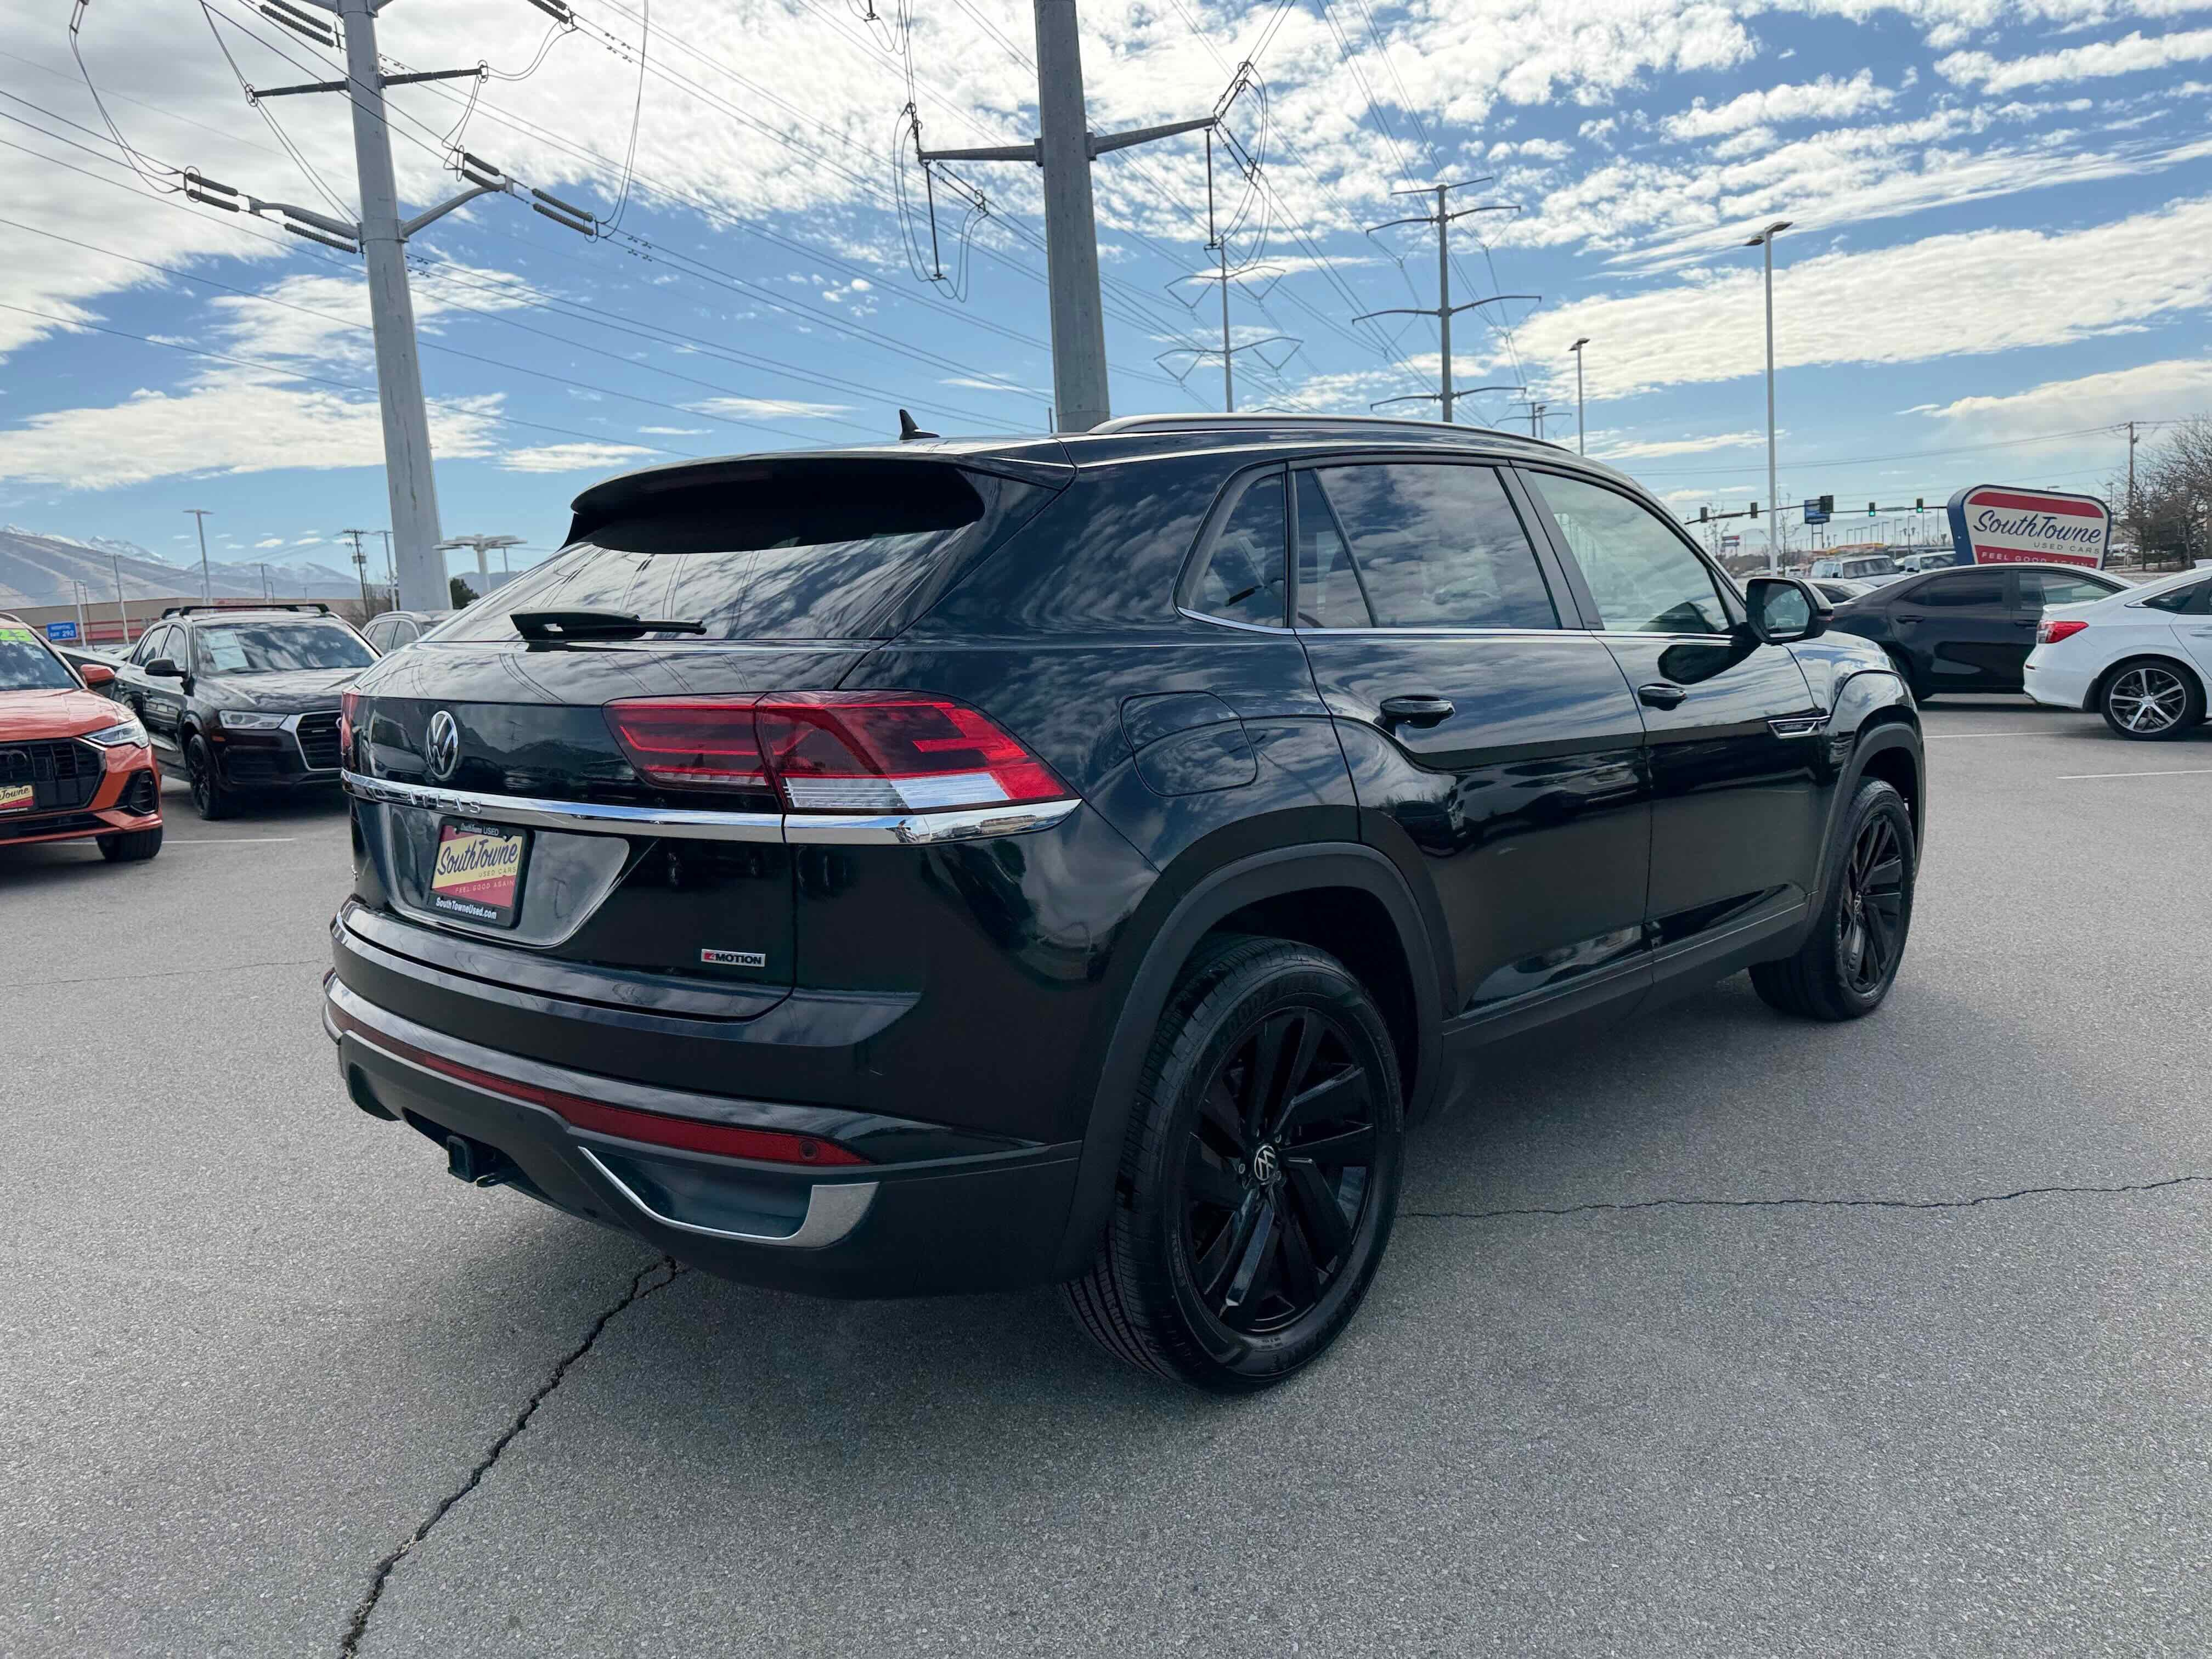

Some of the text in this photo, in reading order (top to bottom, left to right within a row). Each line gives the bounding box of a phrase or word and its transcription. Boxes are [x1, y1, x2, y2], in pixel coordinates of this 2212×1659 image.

[1973, 510, 2101, 544] SouthTowne
[2034, 542, 2100, 554] USED CARS
[1982, 552, 2010, 561] FEEL
[0, 788, 29, 799] Towne
[483, 826, 499, 836] USED
[437, 839, 518, 875] SouthTowne
[478, 870, 495, 878] USED
[473, 883, 490, 891] GOOD
[436, 897, 496, 919] SouthTowneUsed.com
